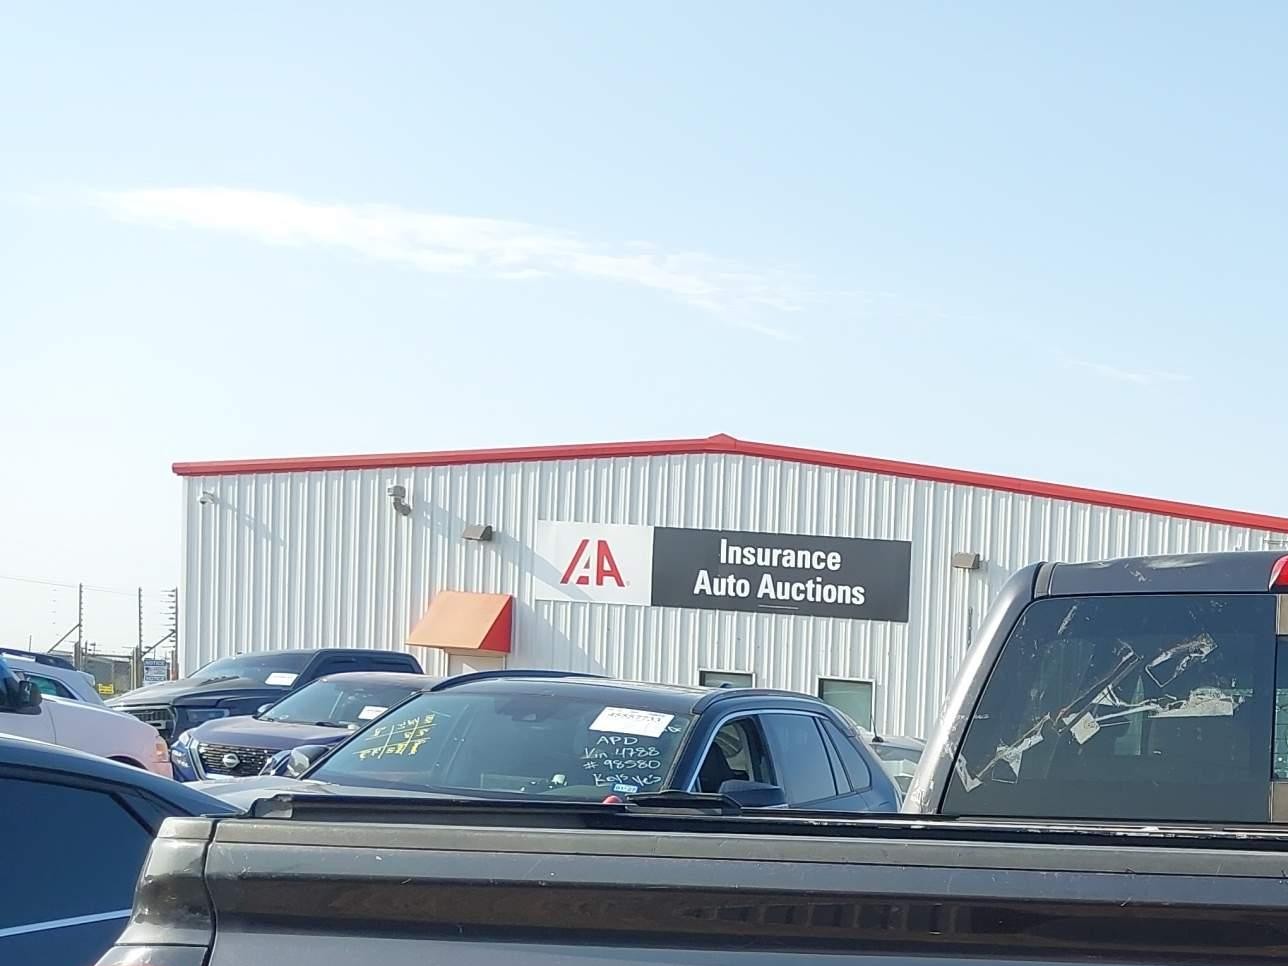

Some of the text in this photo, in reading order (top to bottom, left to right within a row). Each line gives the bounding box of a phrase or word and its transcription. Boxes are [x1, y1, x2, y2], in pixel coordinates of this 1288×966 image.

[719, 538, 842, 572] Insurance
[692, 569, 866, 606] Auto Auctions
[596, 735, 638, 745] APD
[615, 746, 660, 758] 4788
